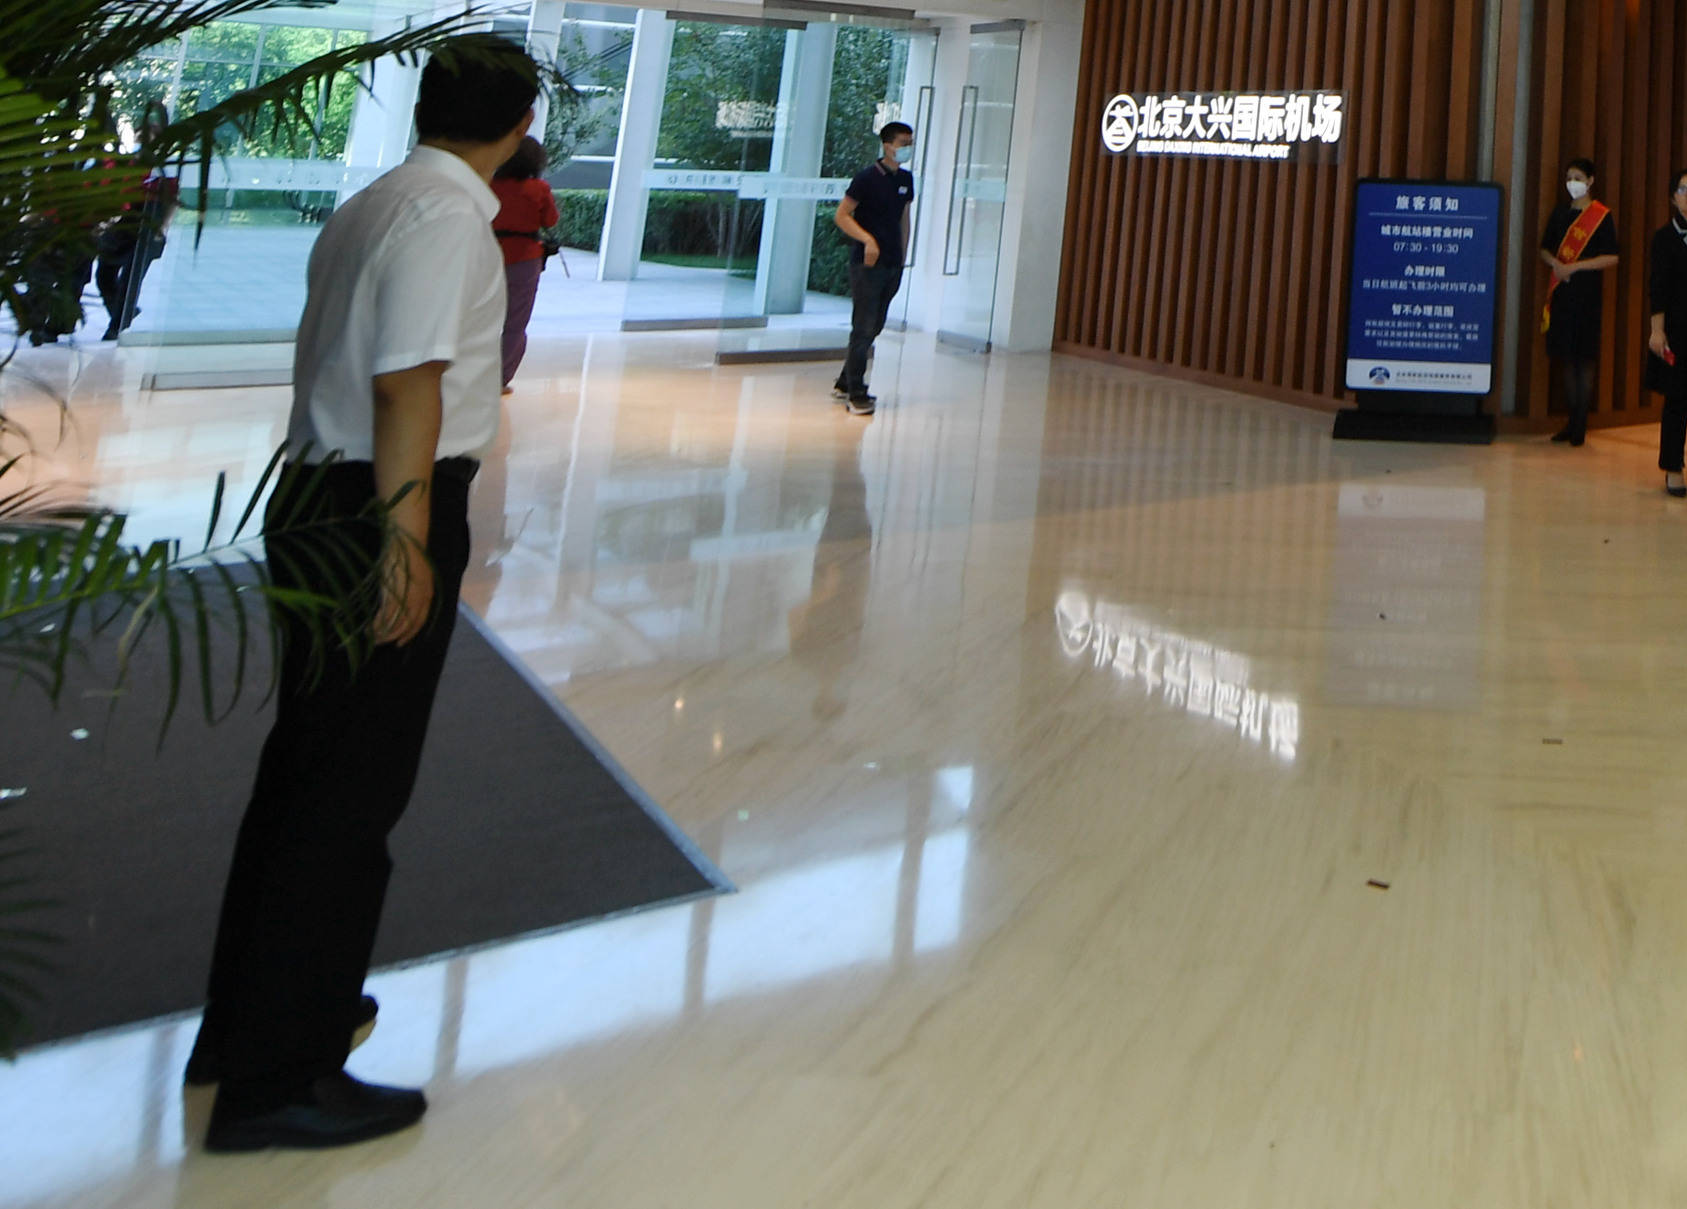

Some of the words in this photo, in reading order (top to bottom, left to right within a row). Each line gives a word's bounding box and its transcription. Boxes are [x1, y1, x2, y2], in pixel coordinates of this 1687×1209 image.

[1137, 93, 1343, 143] 北京大兴国际机场
[1251, 143, 1291, 159] AIRPORT
[1395, 194, 1459, 212] 旅客须知
[1381, 224, 1474, 240] 城市航站楼营业时间
[1404, 264, 1446, 278] 办理时限
[1392, 303, 1455, 318] 暂不办理范围
